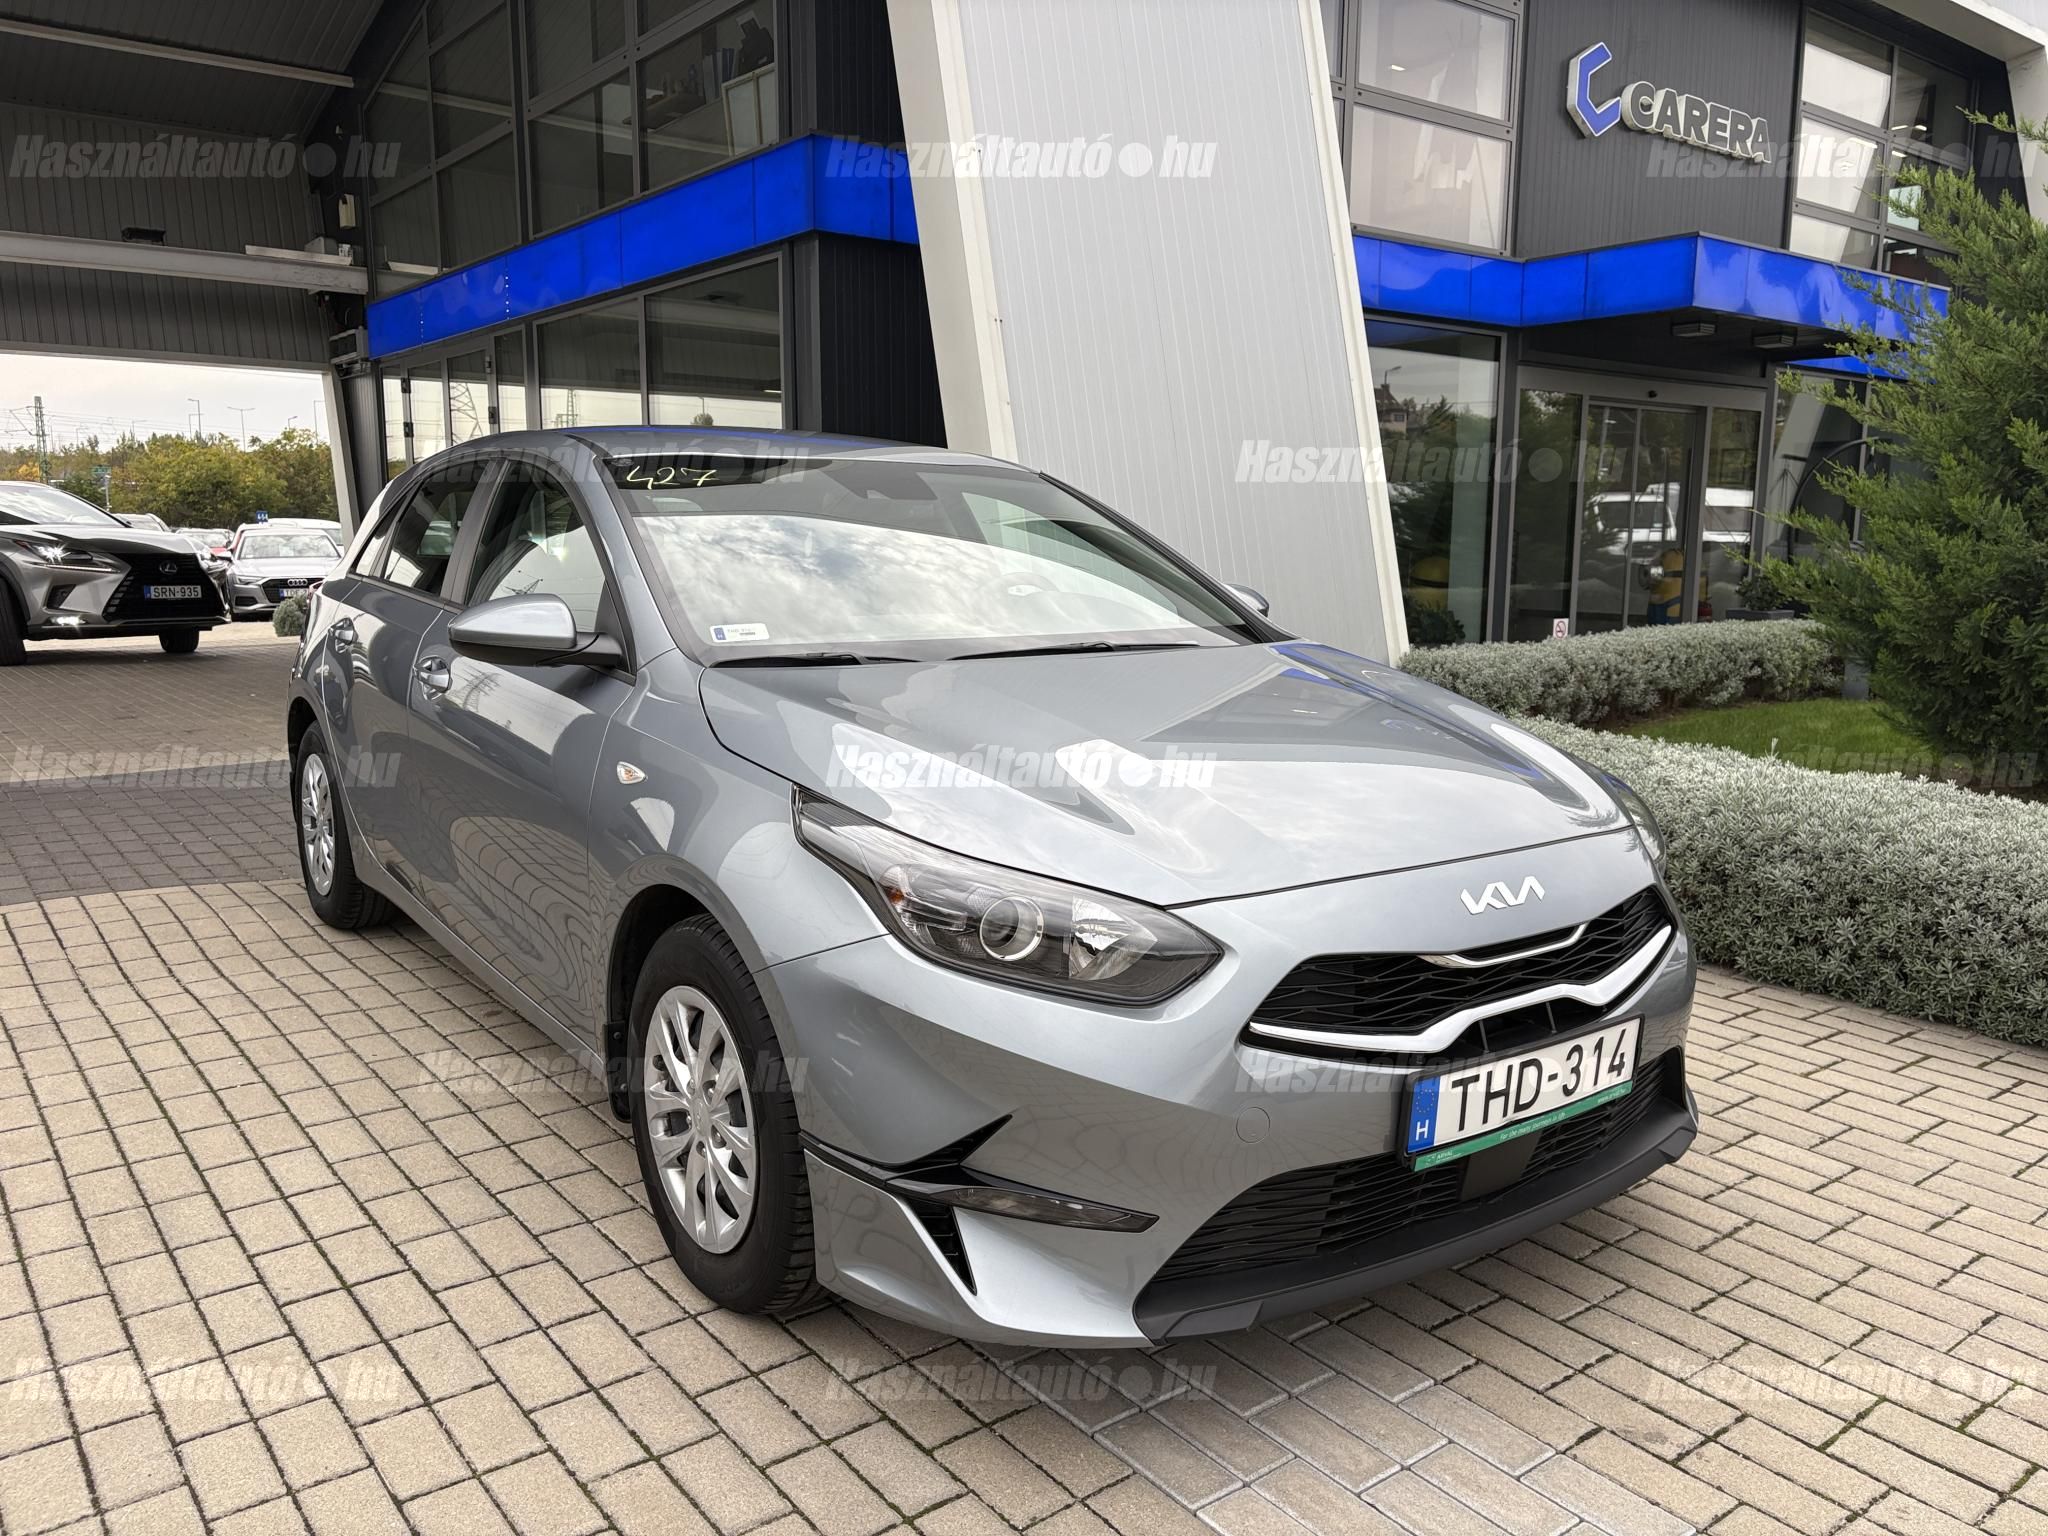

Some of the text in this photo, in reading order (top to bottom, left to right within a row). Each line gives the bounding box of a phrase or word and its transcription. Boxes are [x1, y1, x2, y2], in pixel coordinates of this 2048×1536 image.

[1622, 80, 1772, 164] CARERA
[626, 465, 720, 490] 427
[153, 586, 199, 598] SRN-935
[1460, 875, 1545, 915] KIA
[1415, 1028, 1626, 1141] H THD-314
